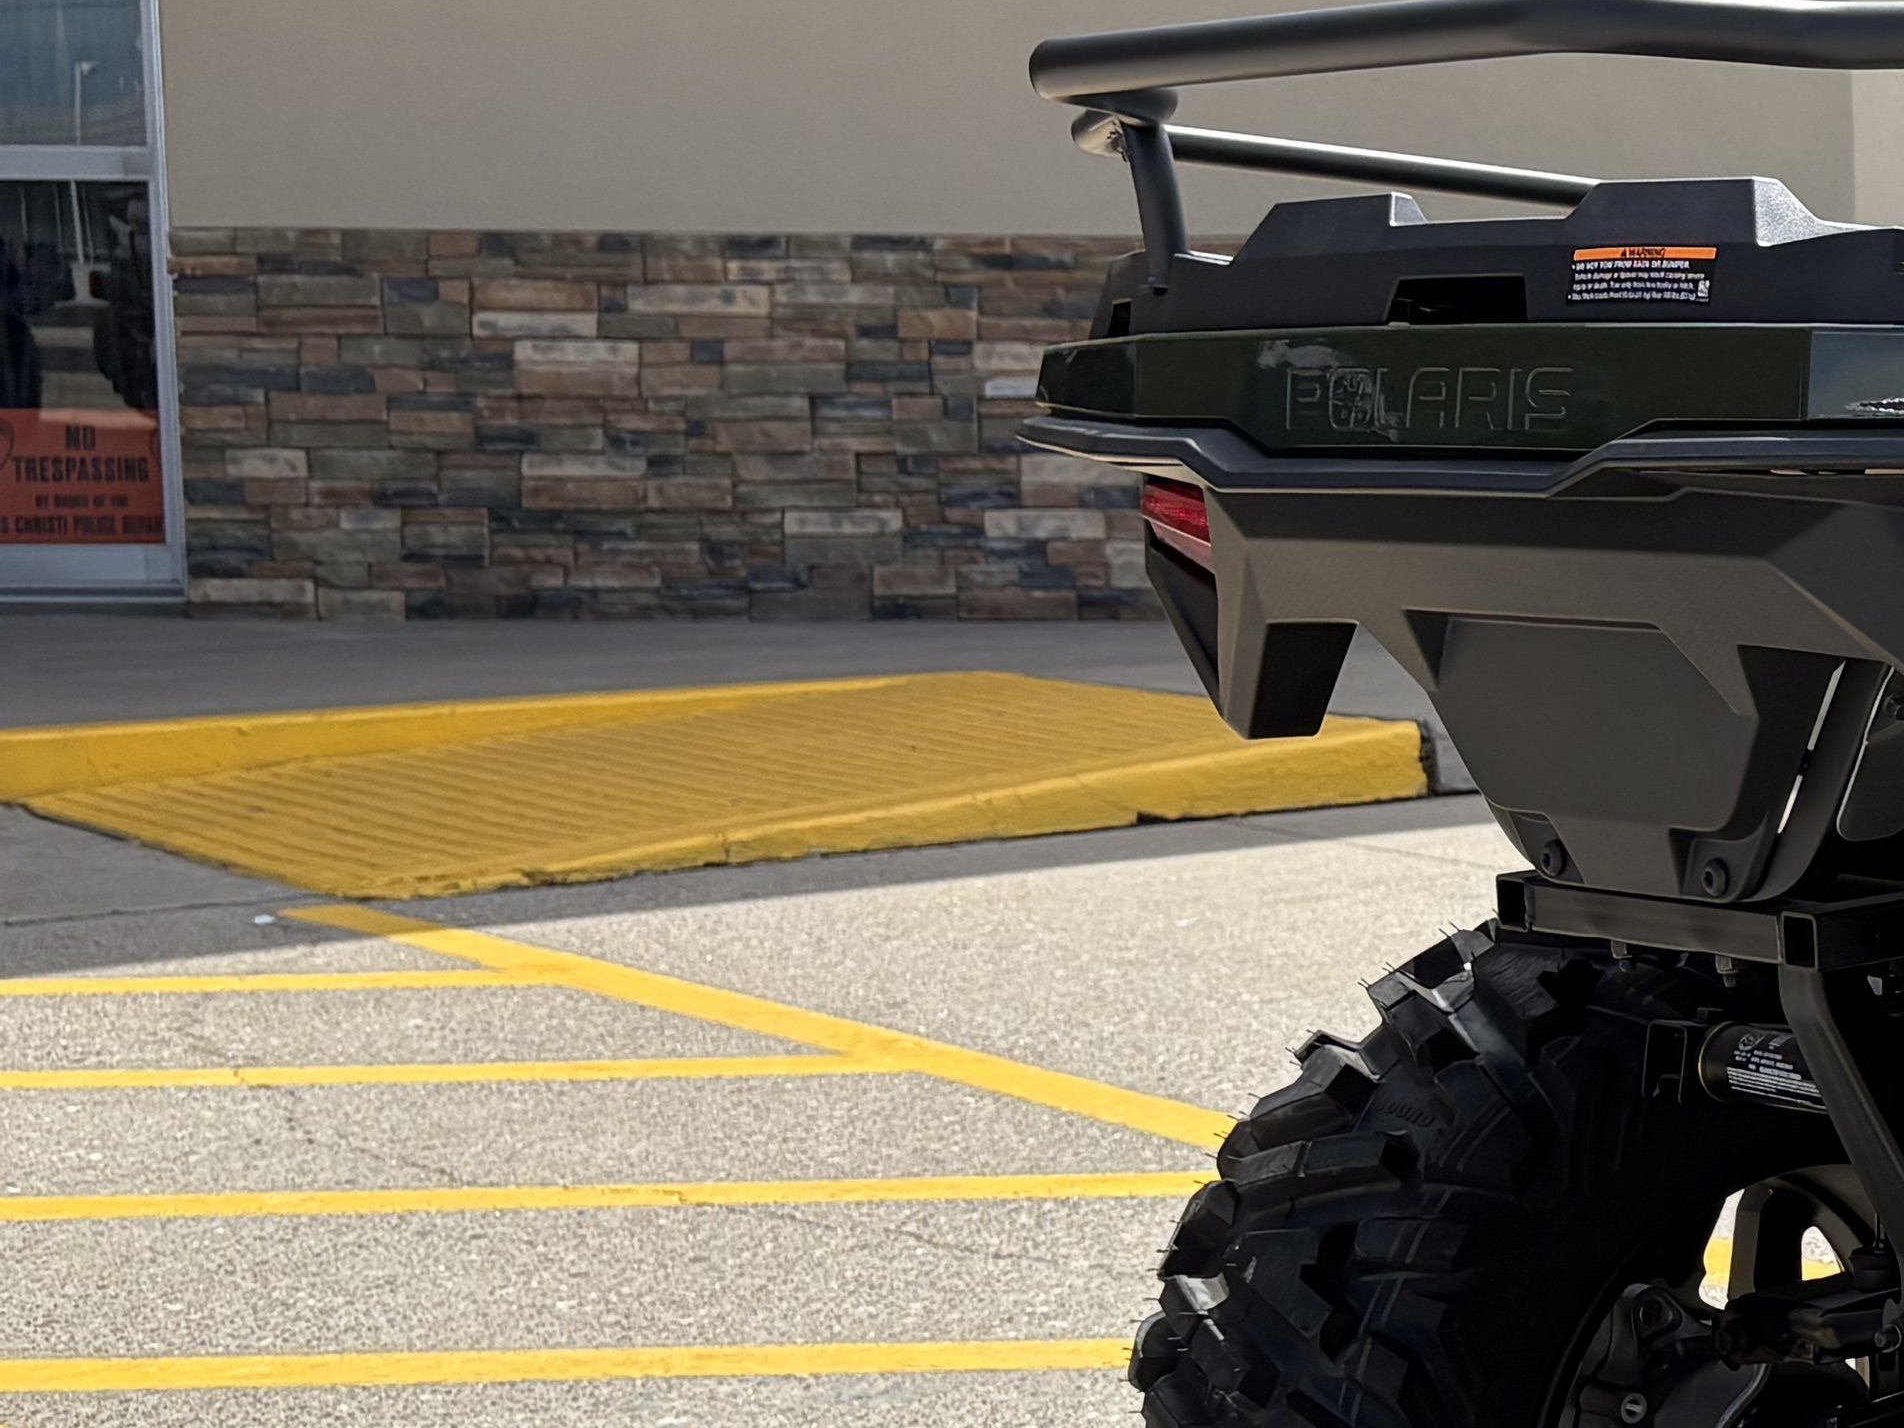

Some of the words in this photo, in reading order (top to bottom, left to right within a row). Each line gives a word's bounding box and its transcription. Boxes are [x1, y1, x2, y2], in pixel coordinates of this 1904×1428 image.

[1286, 367, 1573, 430] POLARIS
[65, 425, 96, 450] NO
[13, 456, 150, 482] TRESPASSING
